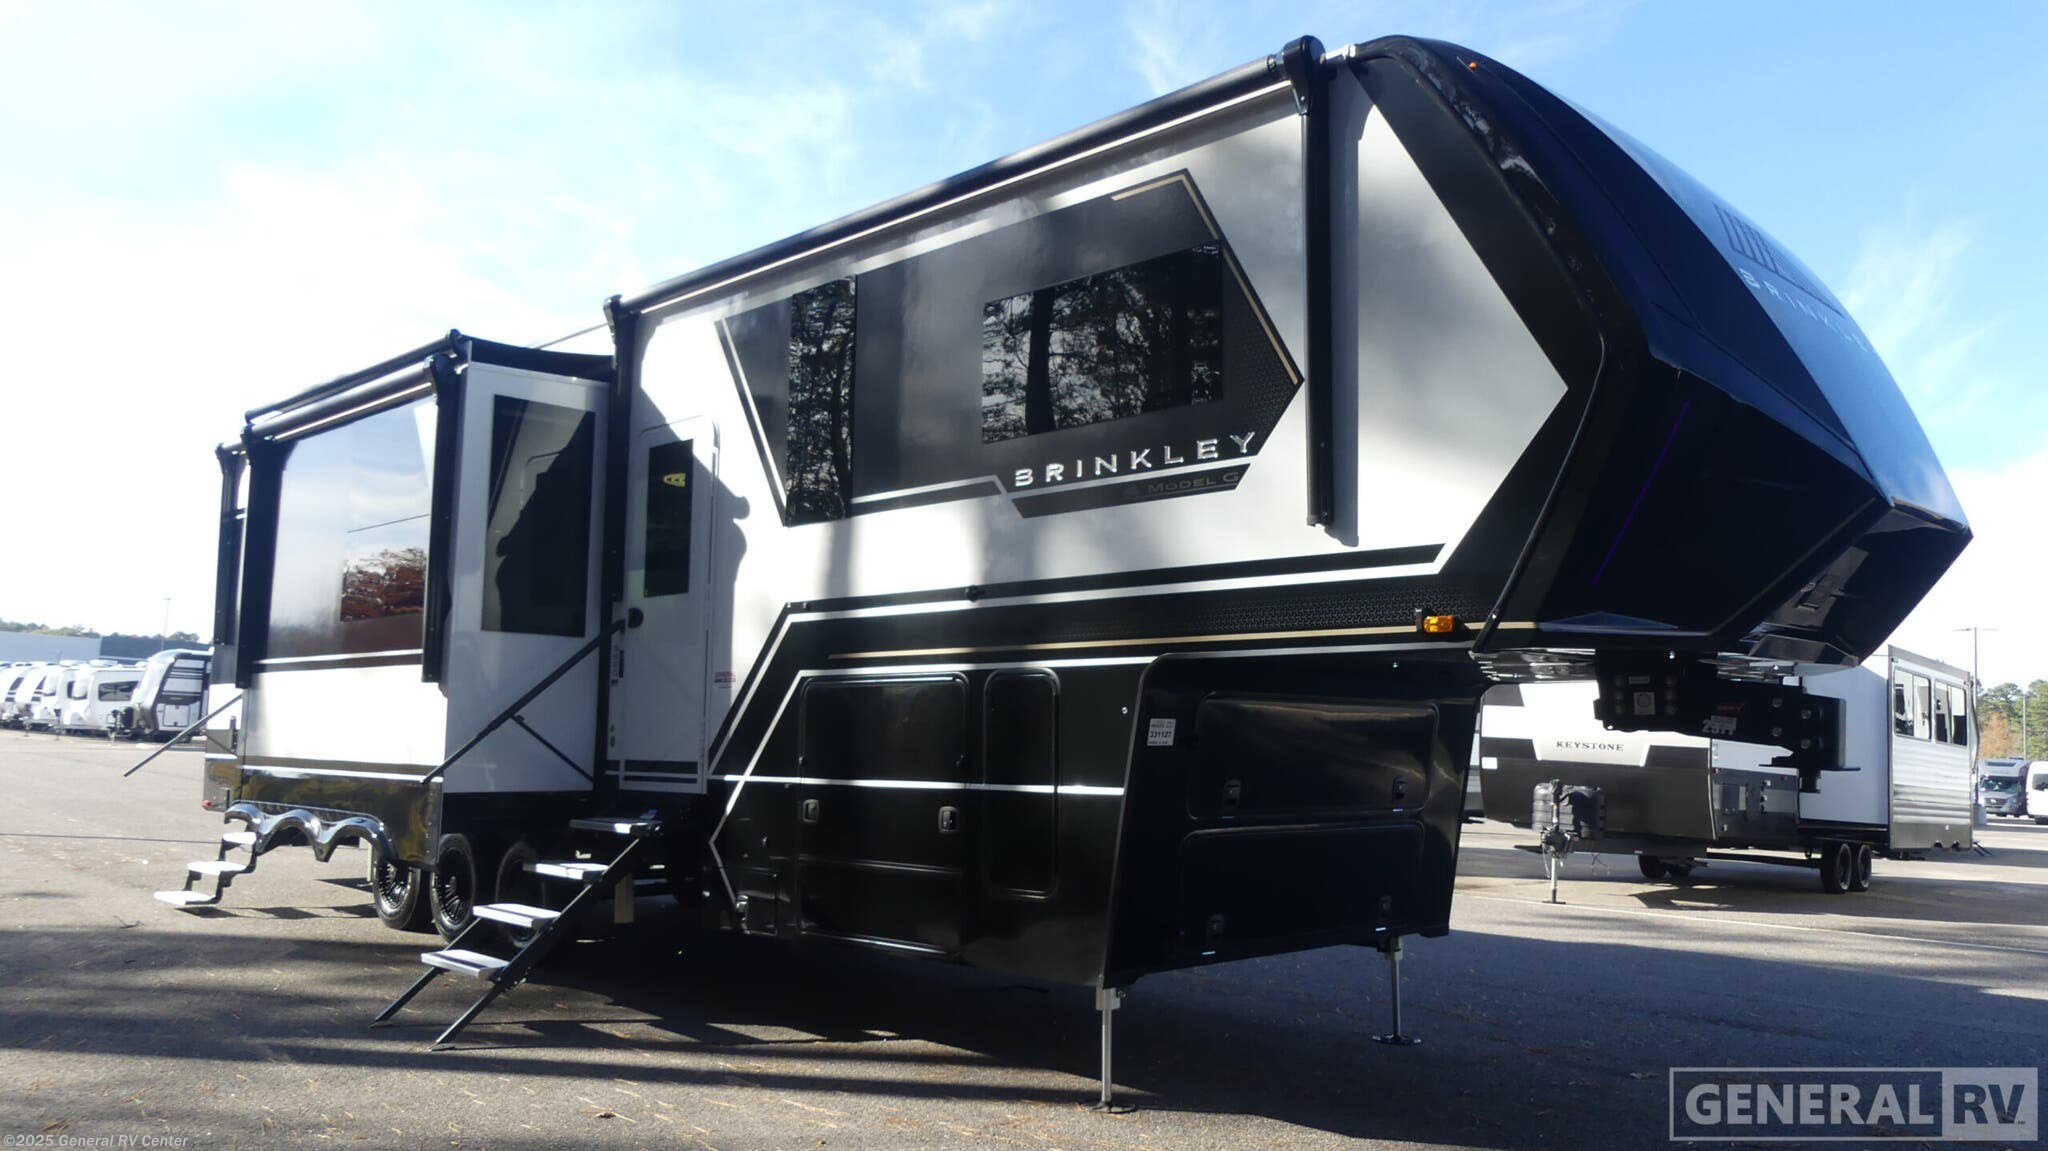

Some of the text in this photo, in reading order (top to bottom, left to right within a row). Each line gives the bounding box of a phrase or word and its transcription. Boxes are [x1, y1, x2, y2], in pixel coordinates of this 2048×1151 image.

[1738, 267, 1869, 353] BRINKL
[1014, 431, 1256, 487] BRINKLEY
[1148, 471, 1240, 493] MODEL G
[1556, 740, 1625, 752] KEYSTONE
